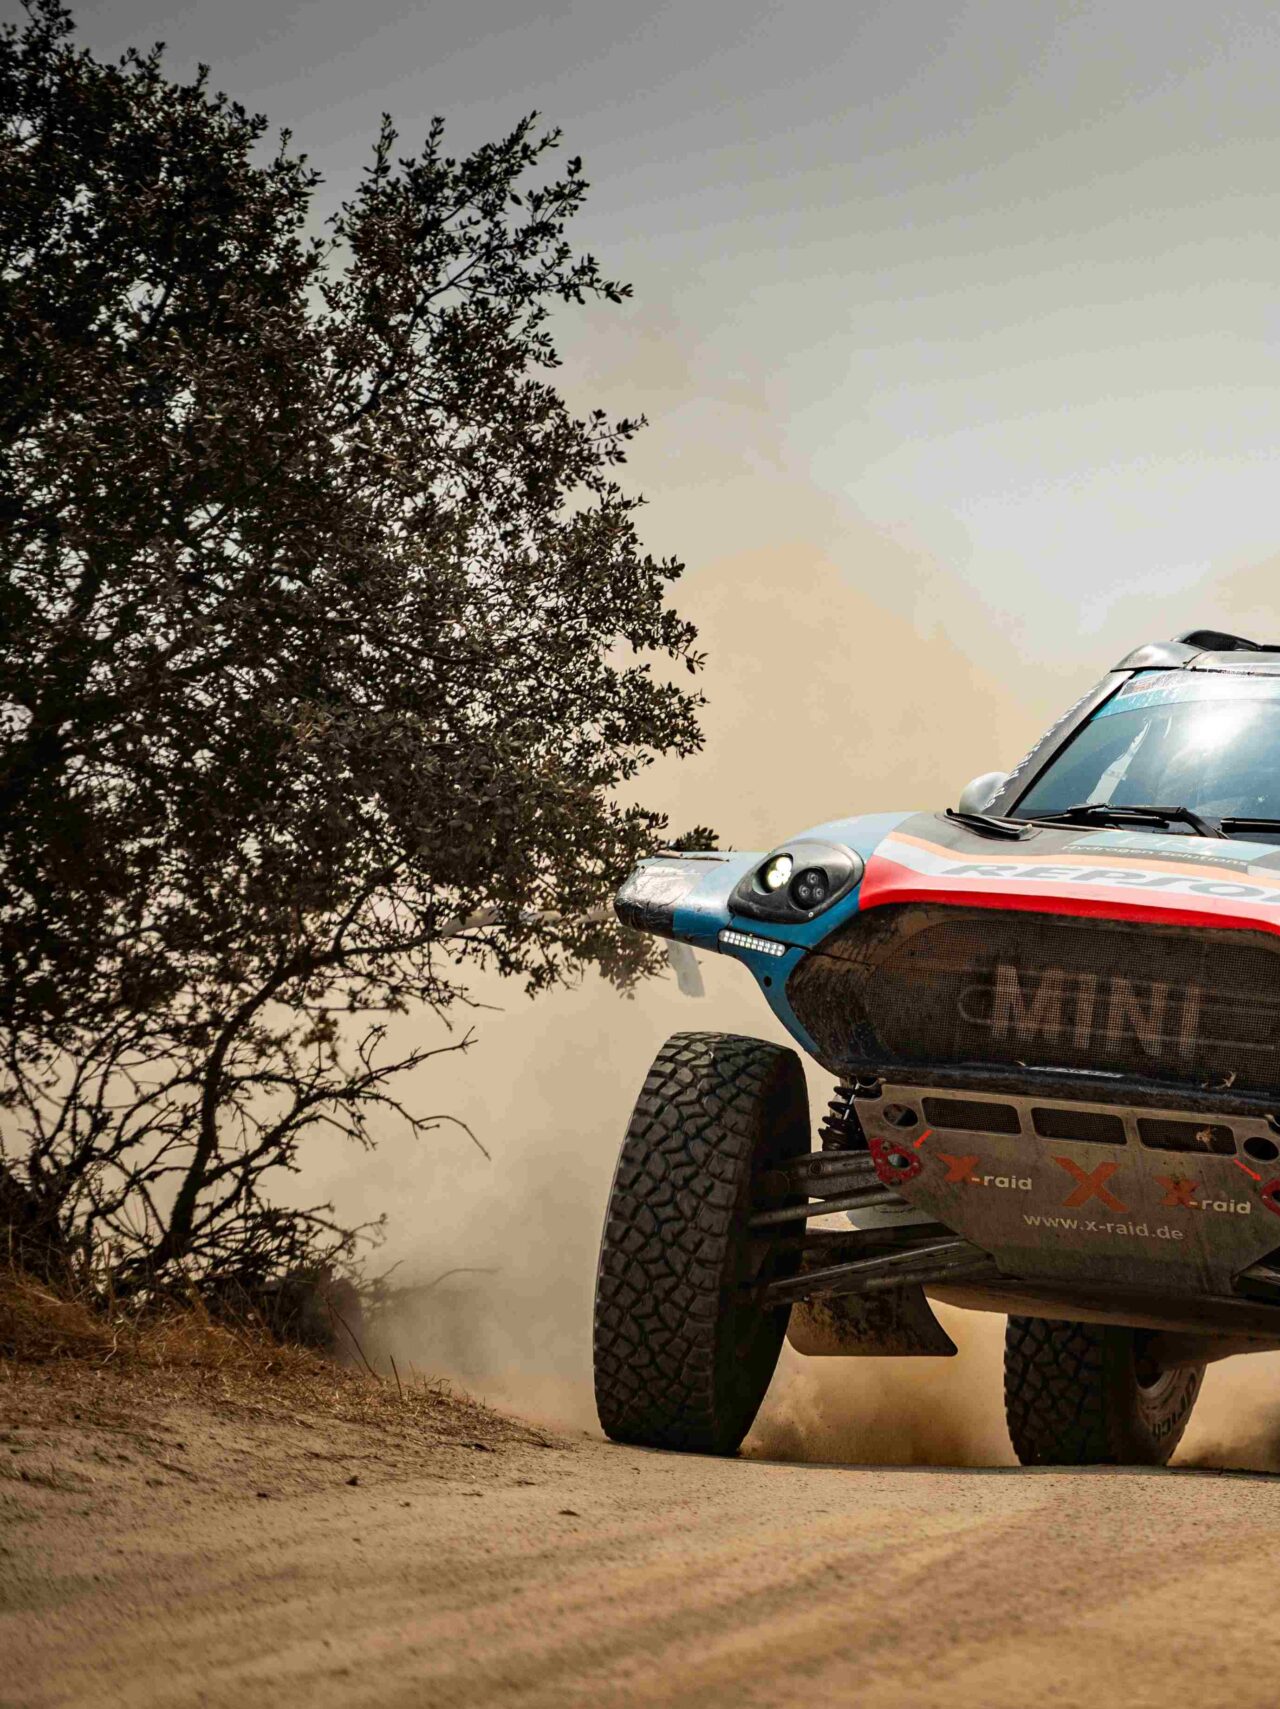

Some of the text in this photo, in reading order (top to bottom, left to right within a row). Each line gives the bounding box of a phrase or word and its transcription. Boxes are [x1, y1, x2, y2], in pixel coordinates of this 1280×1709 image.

[991, 964, 1204, 1057] MINI
[1054, 1155, 1129, 1214] X
[1023, 1212, 1184, 1240] www.x-raid.de
